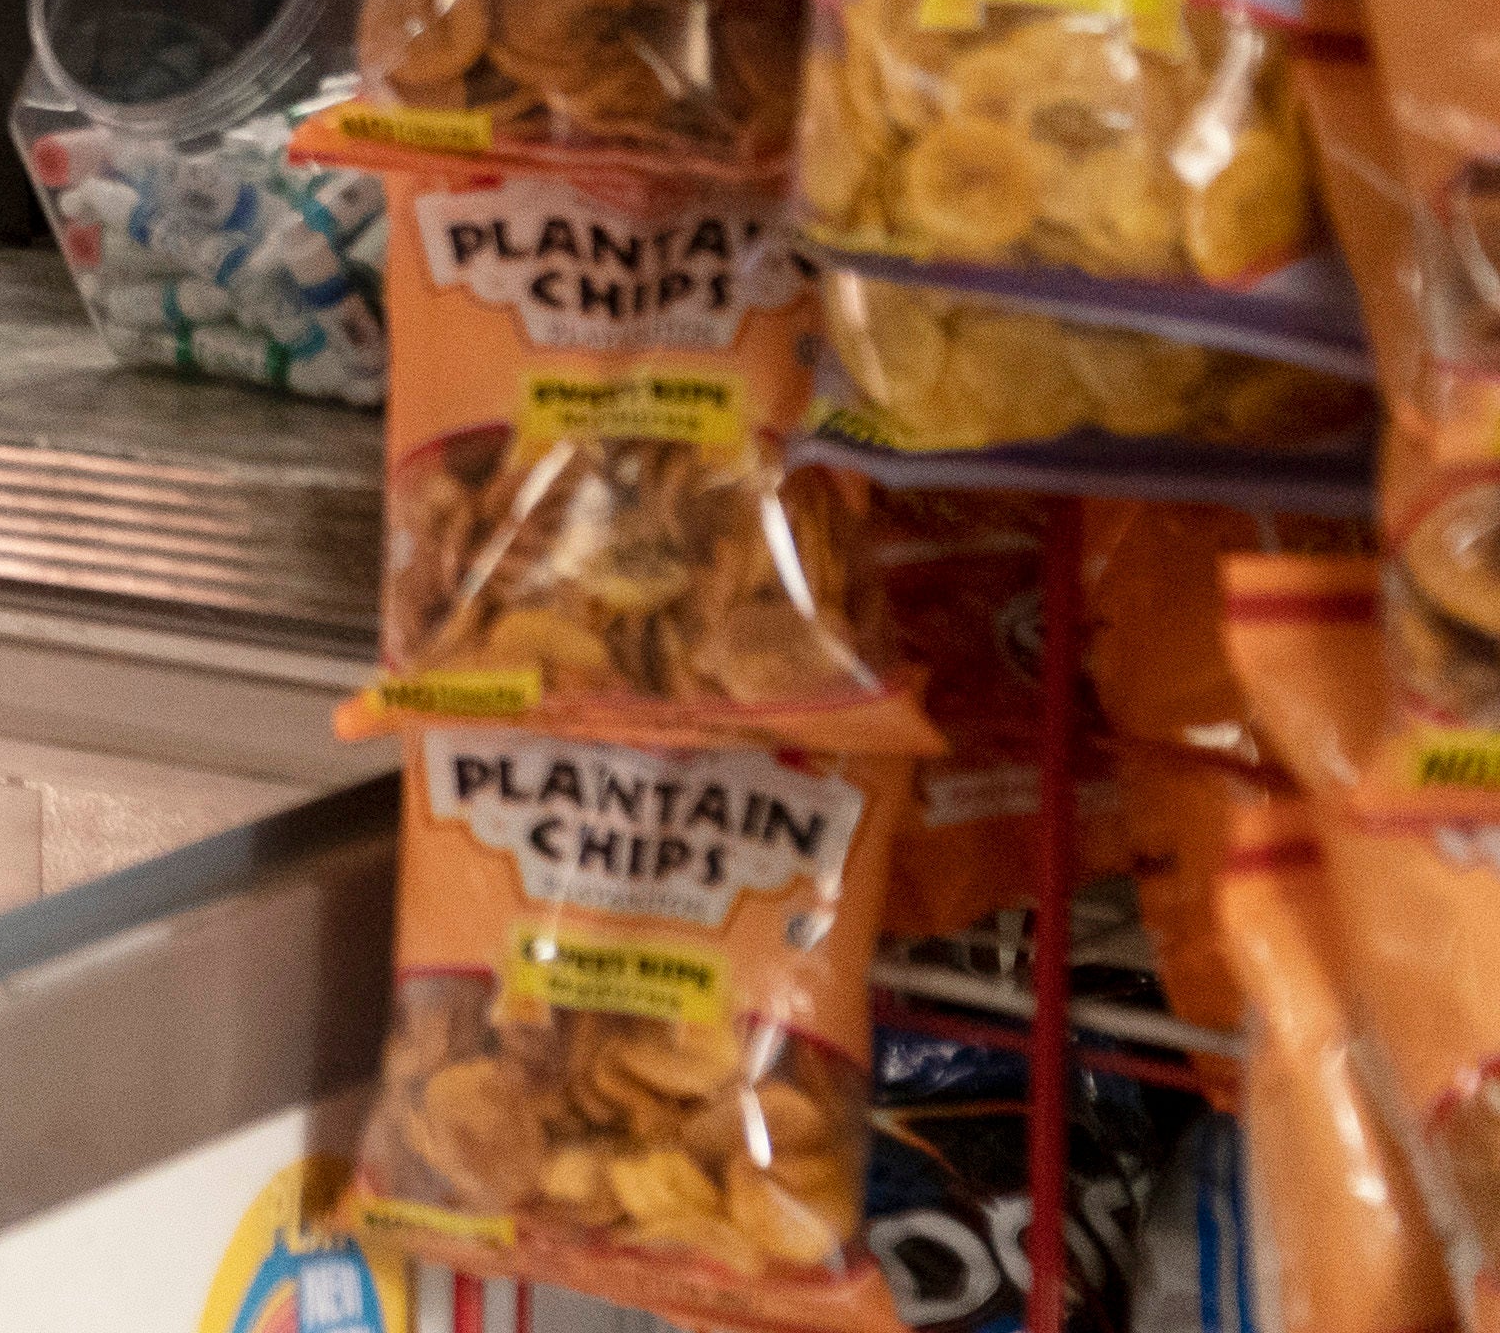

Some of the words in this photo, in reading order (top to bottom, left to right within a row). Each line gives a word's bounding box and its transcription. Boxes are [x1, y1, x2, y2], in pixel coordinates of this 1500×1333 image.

[527, 273, 730, 319] CHIPS
[451, 753, 827, 857] PLANTAIN
[529, 821, 726, 888] CHIPS
